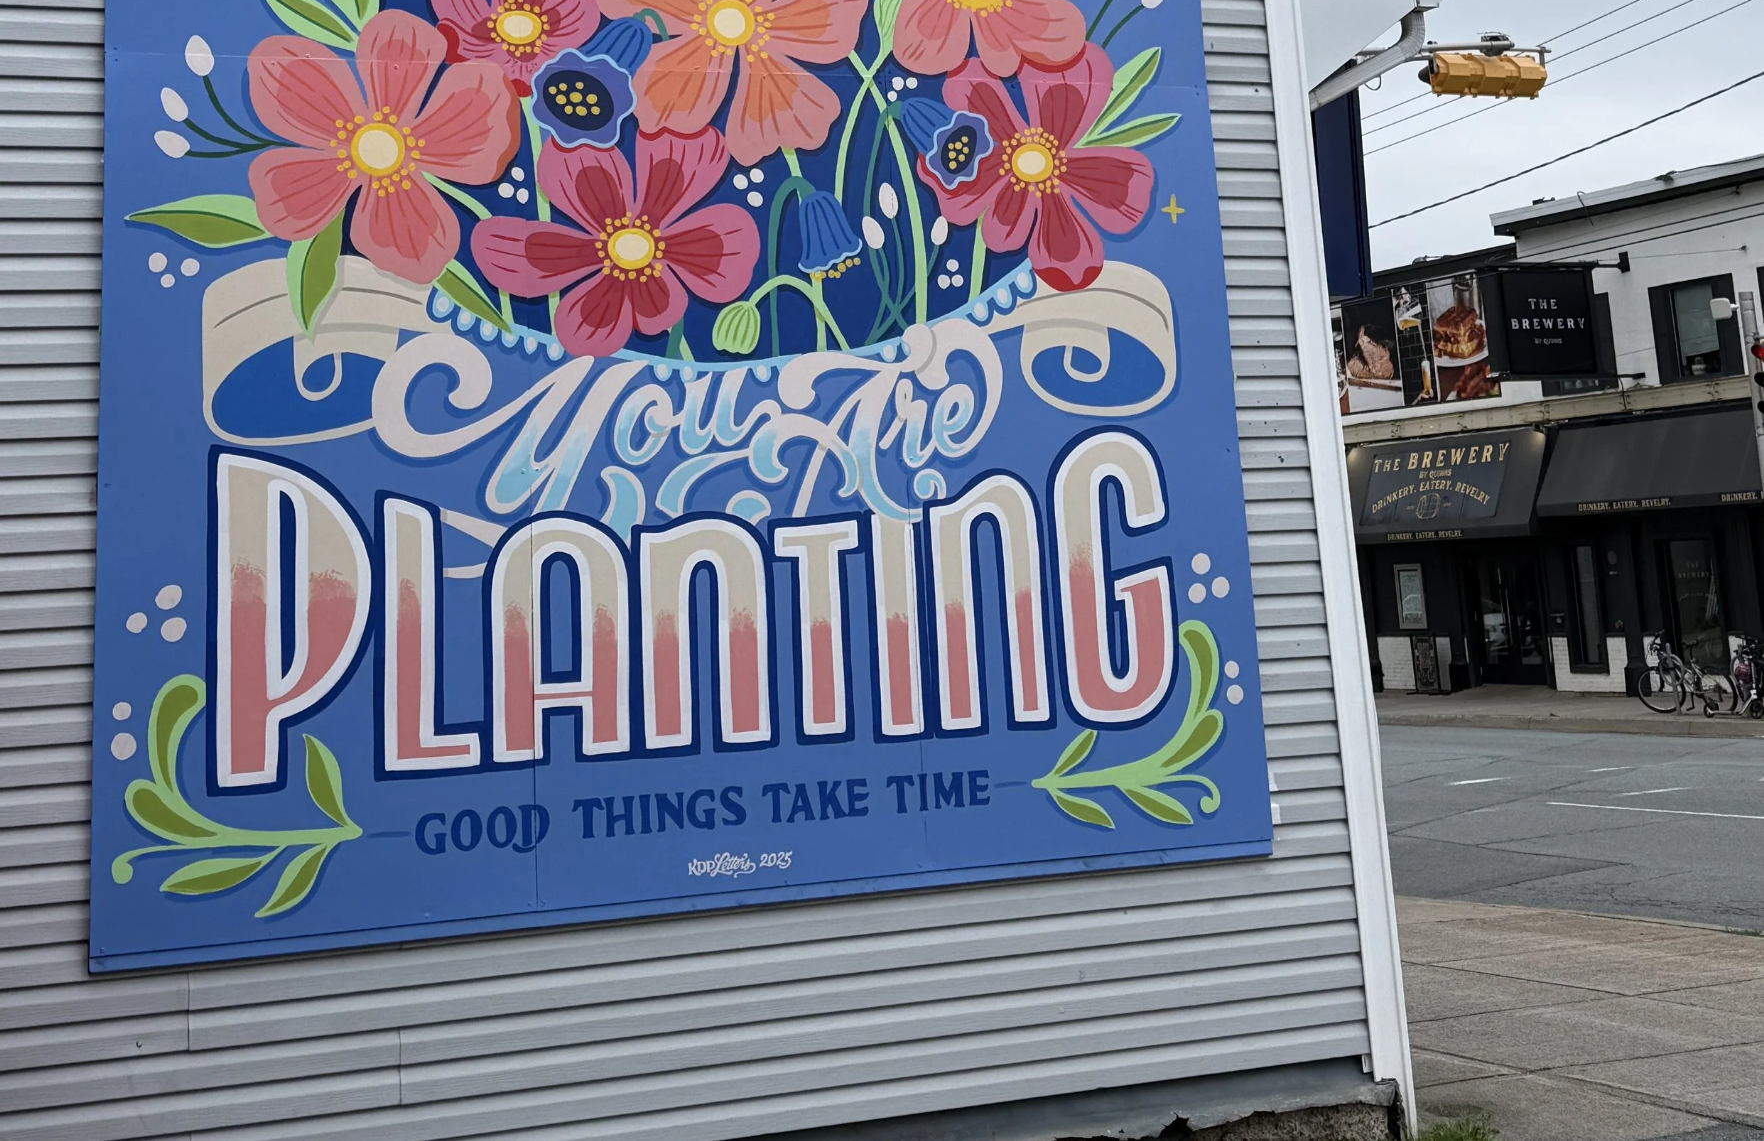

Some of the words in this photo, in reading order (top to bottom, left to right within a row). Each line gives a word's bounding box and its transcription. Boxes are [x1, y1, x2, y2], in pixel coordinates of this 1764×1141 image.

[1528, 298, 1558, 310] THE
[1510, 318, 1585, 330] BREWERY
[371, 331, 776, 523] You
[742, 317, 1003, 523] Are
[1373, 458, 1401, 473] THE
[1407, 442, 1510, 470] BREWERY
[1418, 470, 1428, 479] BY
[1372, 484, 1417, 514] DRINKERY.
[1419, 479, 1452, 492] EATERY.
[1455, 481, 1491, 505] REVELRY
[1721, 492, 1758, 503] DRINKERY.
[210, 426, 1175, 794] PLANTING
[414, 803, 550, 855] GOOD
[572, 785, 747, 840] THINGS
[761, 778, 869, 824] TAKE
[886, 769, 992, 814] TIME
[759, 850, 793, 870] 2025
